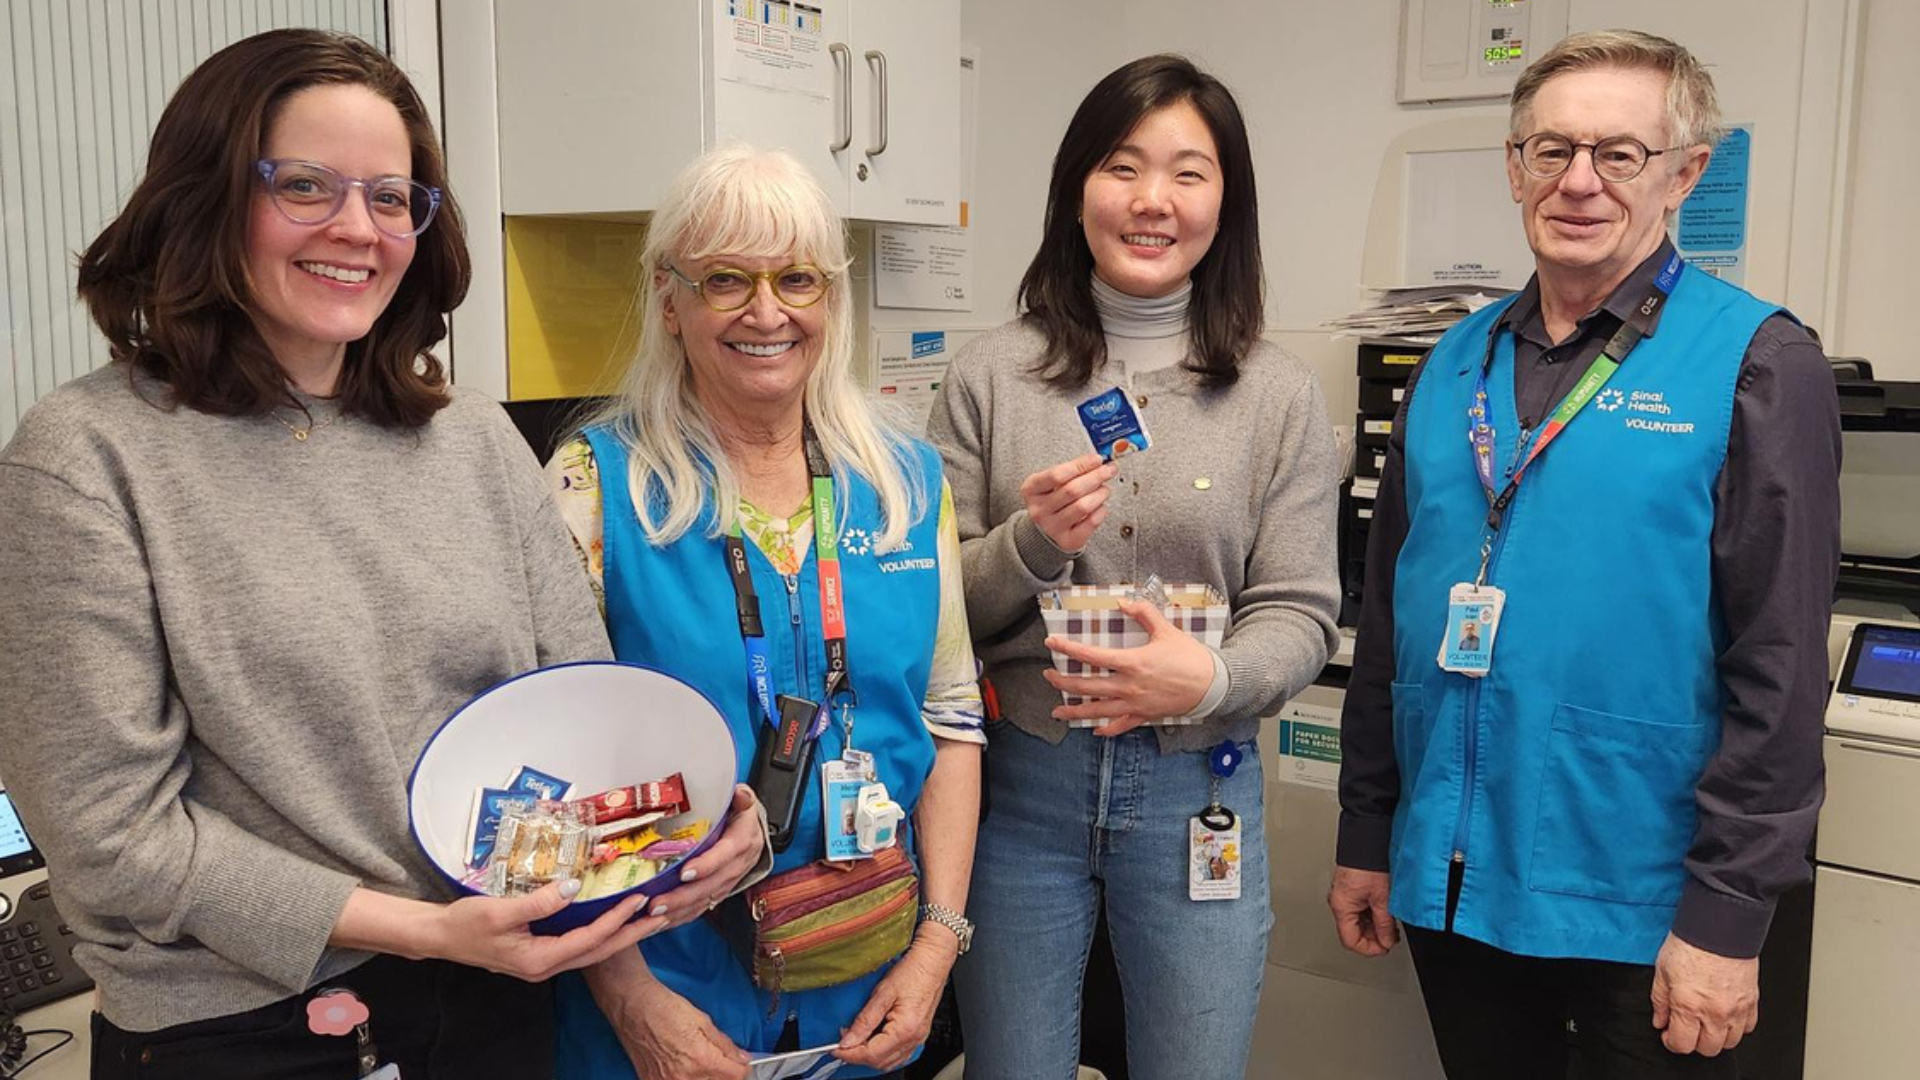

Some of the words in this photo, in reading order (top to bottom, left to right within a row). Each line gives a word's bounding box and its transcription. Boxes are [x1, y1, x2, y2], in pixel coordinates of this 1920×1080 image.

[1631, 391, 1663, 402] Sinai
[1628, 401, 1671, 415] Health
[1626, 418, 1694, 433] VOLUNTEER
[879, 558, 936, 573] VOLUNTEER
[784, 720, 799, 756] ascom
